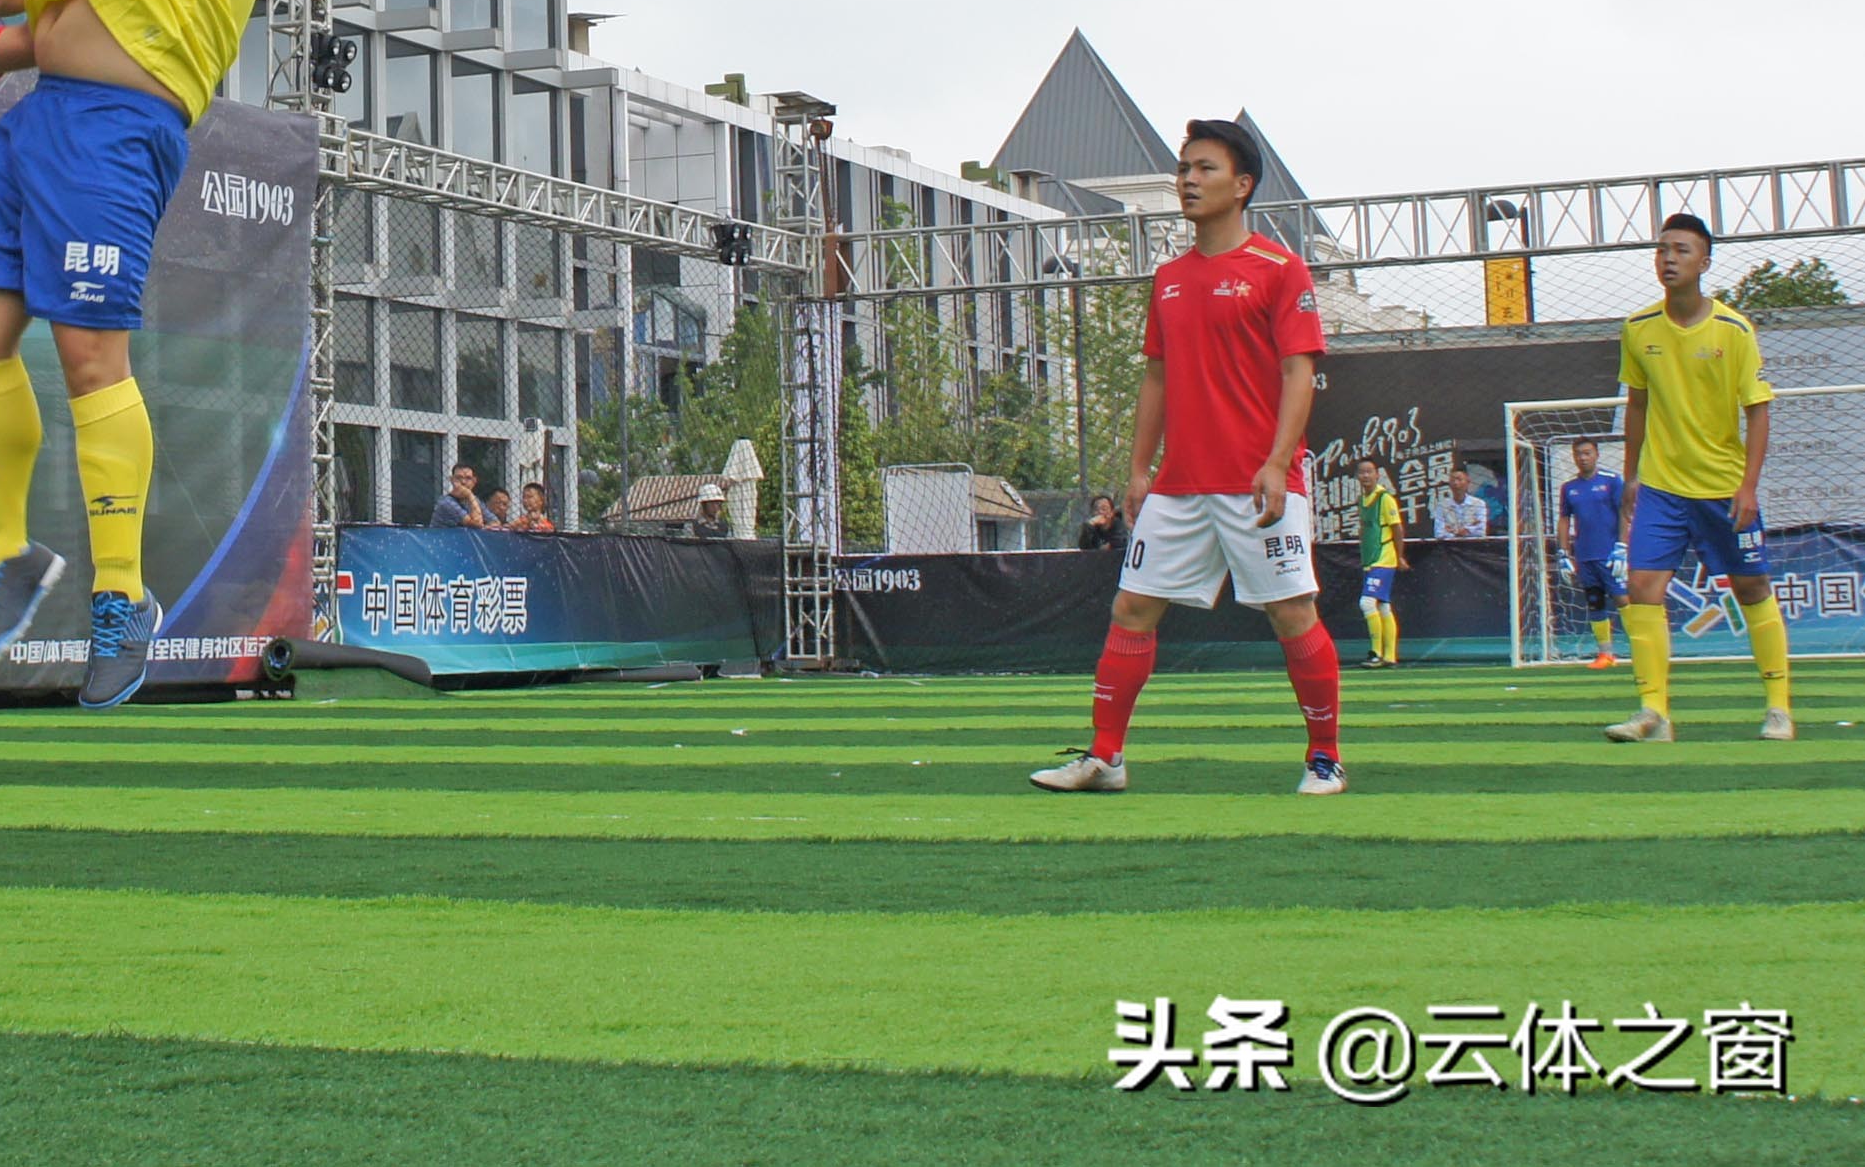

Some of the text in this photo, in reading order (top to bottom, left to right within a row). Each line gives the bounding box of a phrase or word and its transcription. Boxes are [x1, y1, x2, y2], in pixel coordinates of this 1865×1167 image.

[200, 170, 295, 226] 公园1903
[64, 240, 120, 276] 昆明
[1265, 534, 1306, 560] 昆明
[833, 568, 922, 593] 公园1903
[1771, 571, 1865, 620] 中国
[363, 571, 529, 636] 中国体育彩票
